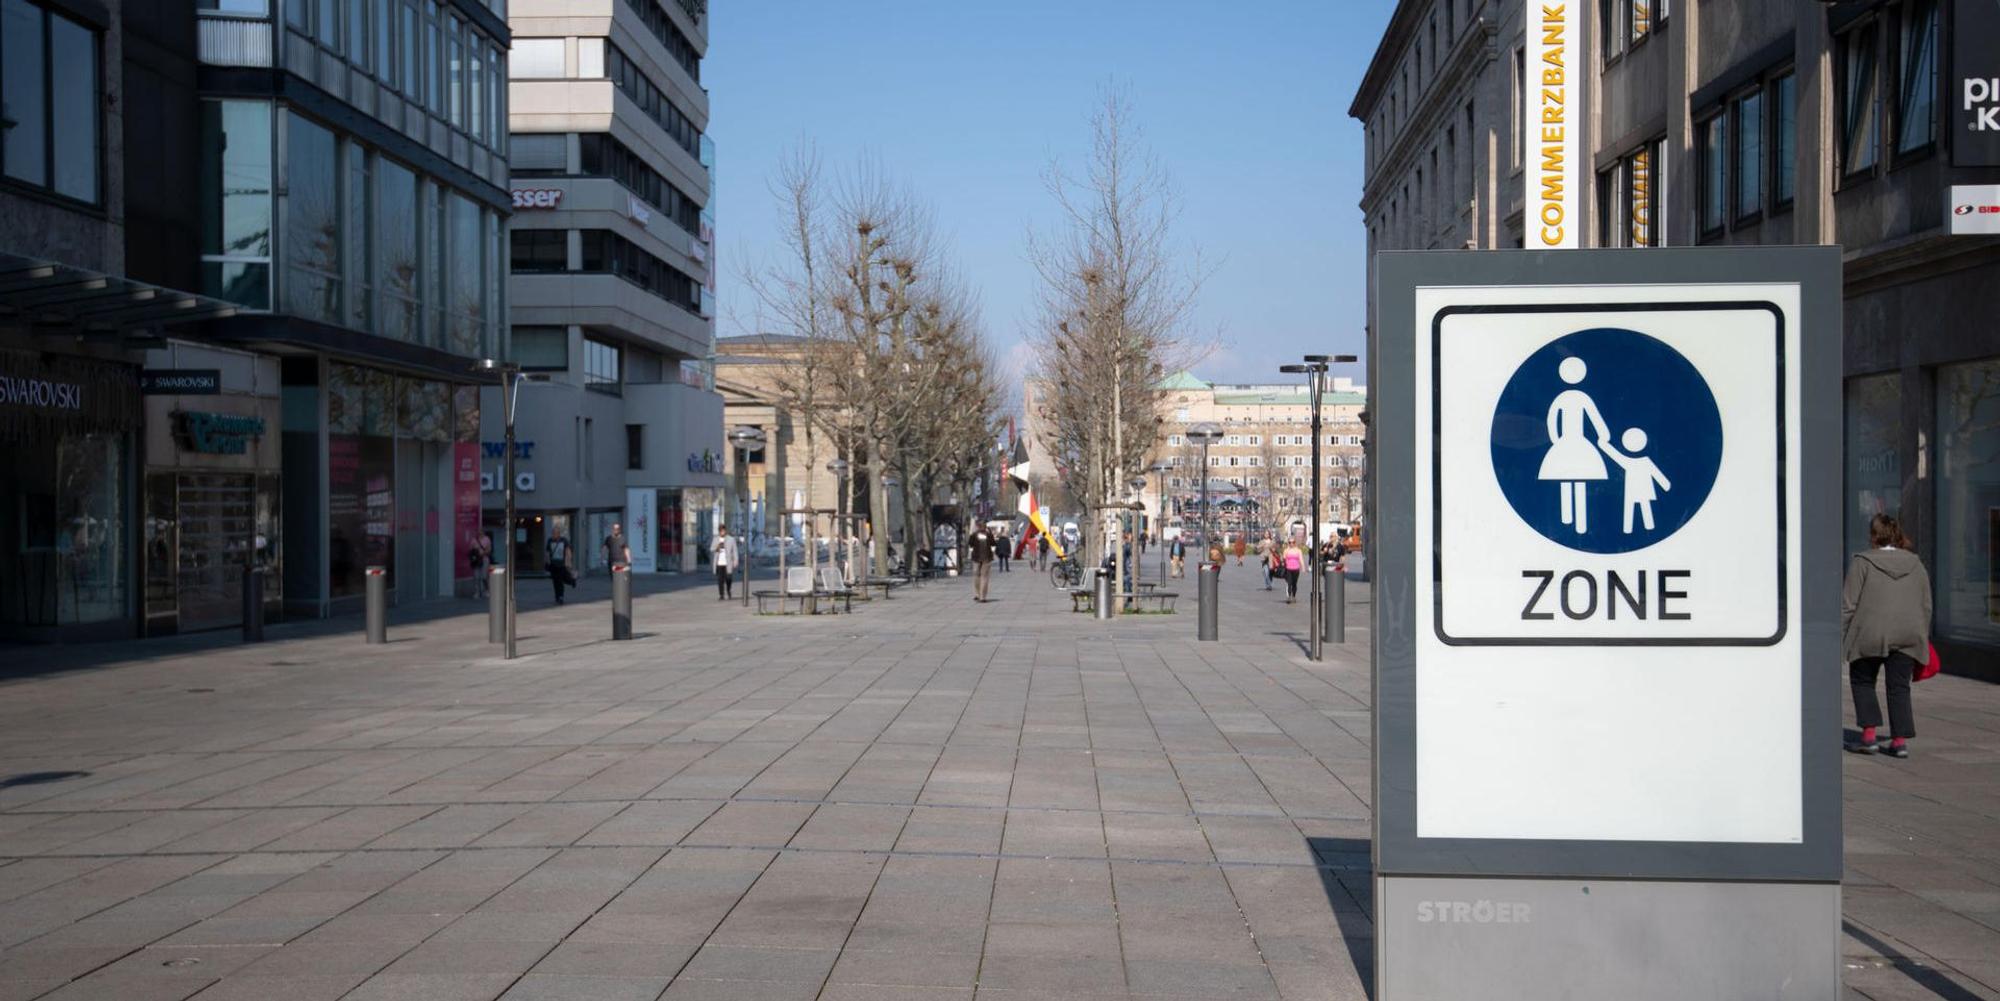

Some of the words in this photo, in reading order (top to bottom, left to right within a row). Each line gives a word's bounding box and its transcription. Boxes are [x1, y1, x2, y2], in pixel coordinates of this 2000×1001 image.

[1541, 4, 1565, 246] COMMERZBANK
[512, 189, 562, 208] sser
[0, 376, 81, 409] SWAROVSKI
[155, 376, 214, 388] SWAROVSKI
[480, 464, 536, 491] ala
[1521, 570, 1692, 620] ZONE
[1417, 899, 1531, 923] STRÖER
